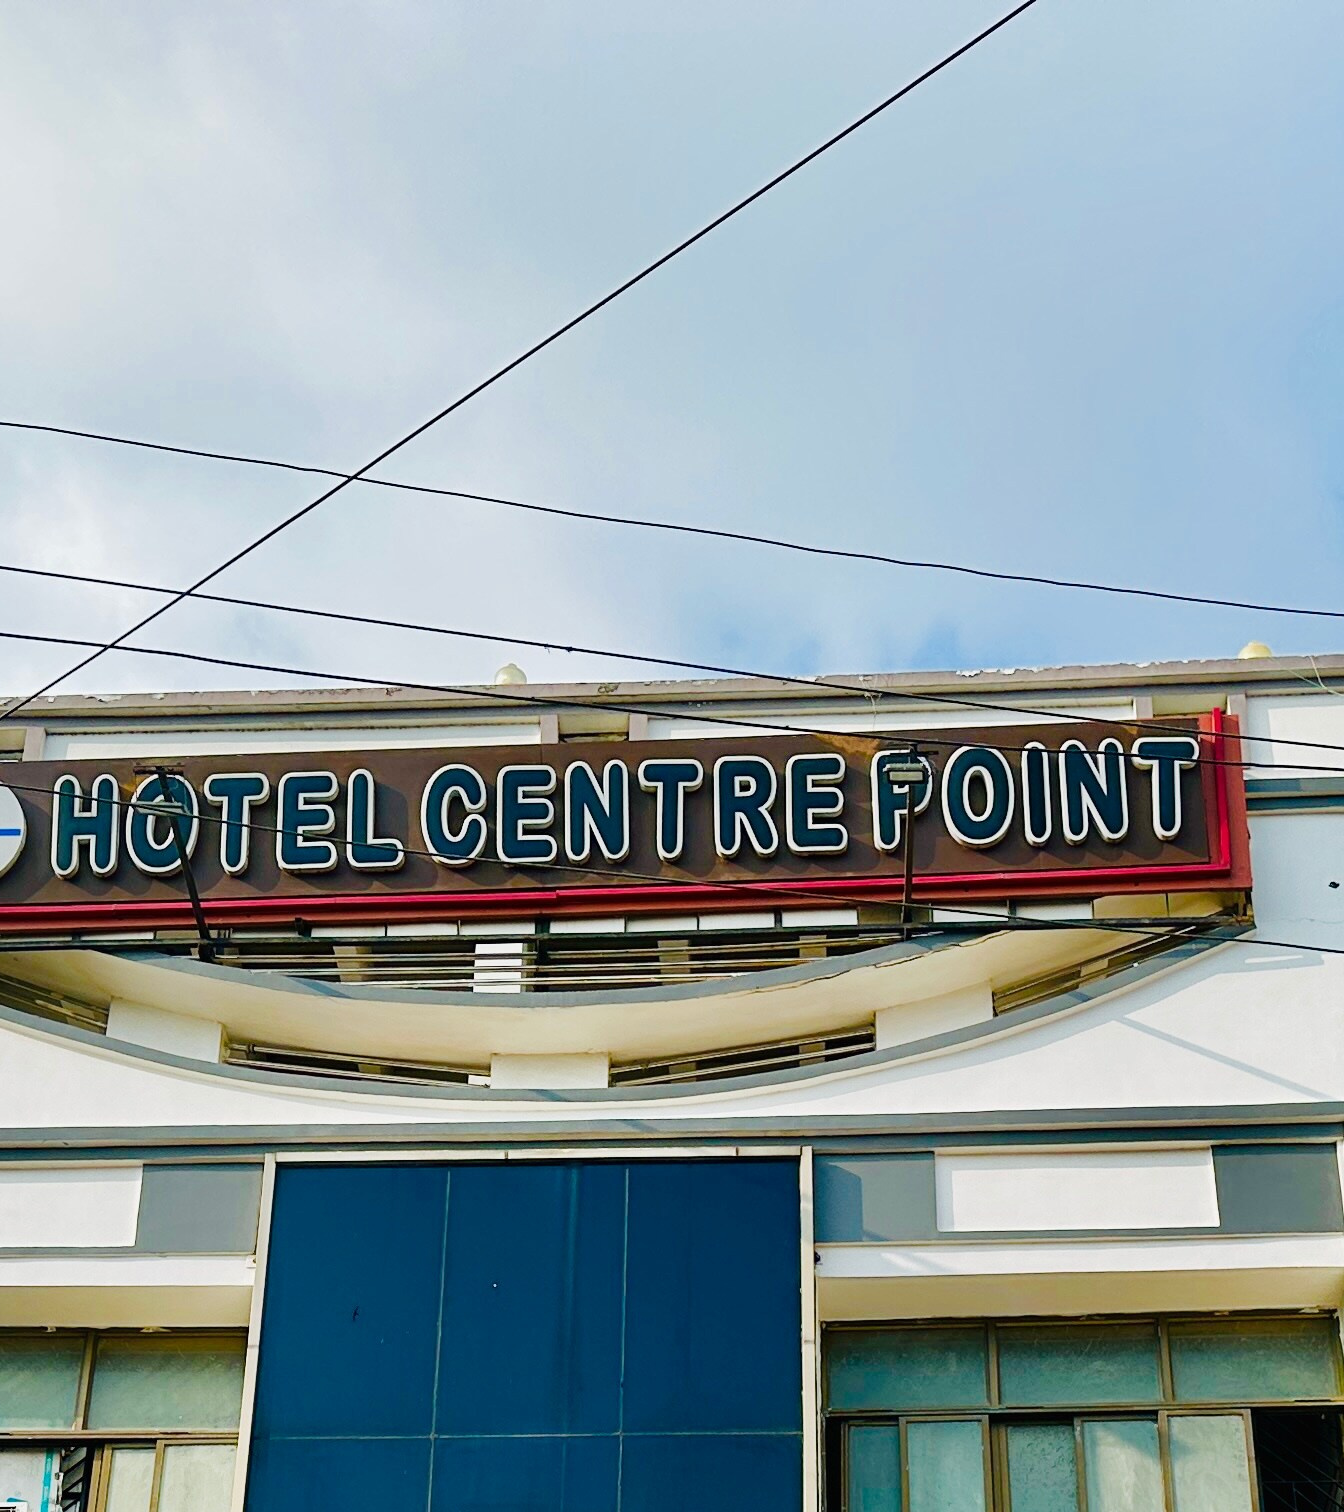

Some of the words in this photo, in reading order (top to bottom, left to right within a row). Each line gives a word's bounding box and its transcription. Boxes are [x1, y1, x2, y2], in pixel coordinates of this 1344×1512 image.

[51, 767, 404, 880] HOTEL
[420, 752, 848, 867] CENTRE
[873, 736, 1200, 852] POINT
